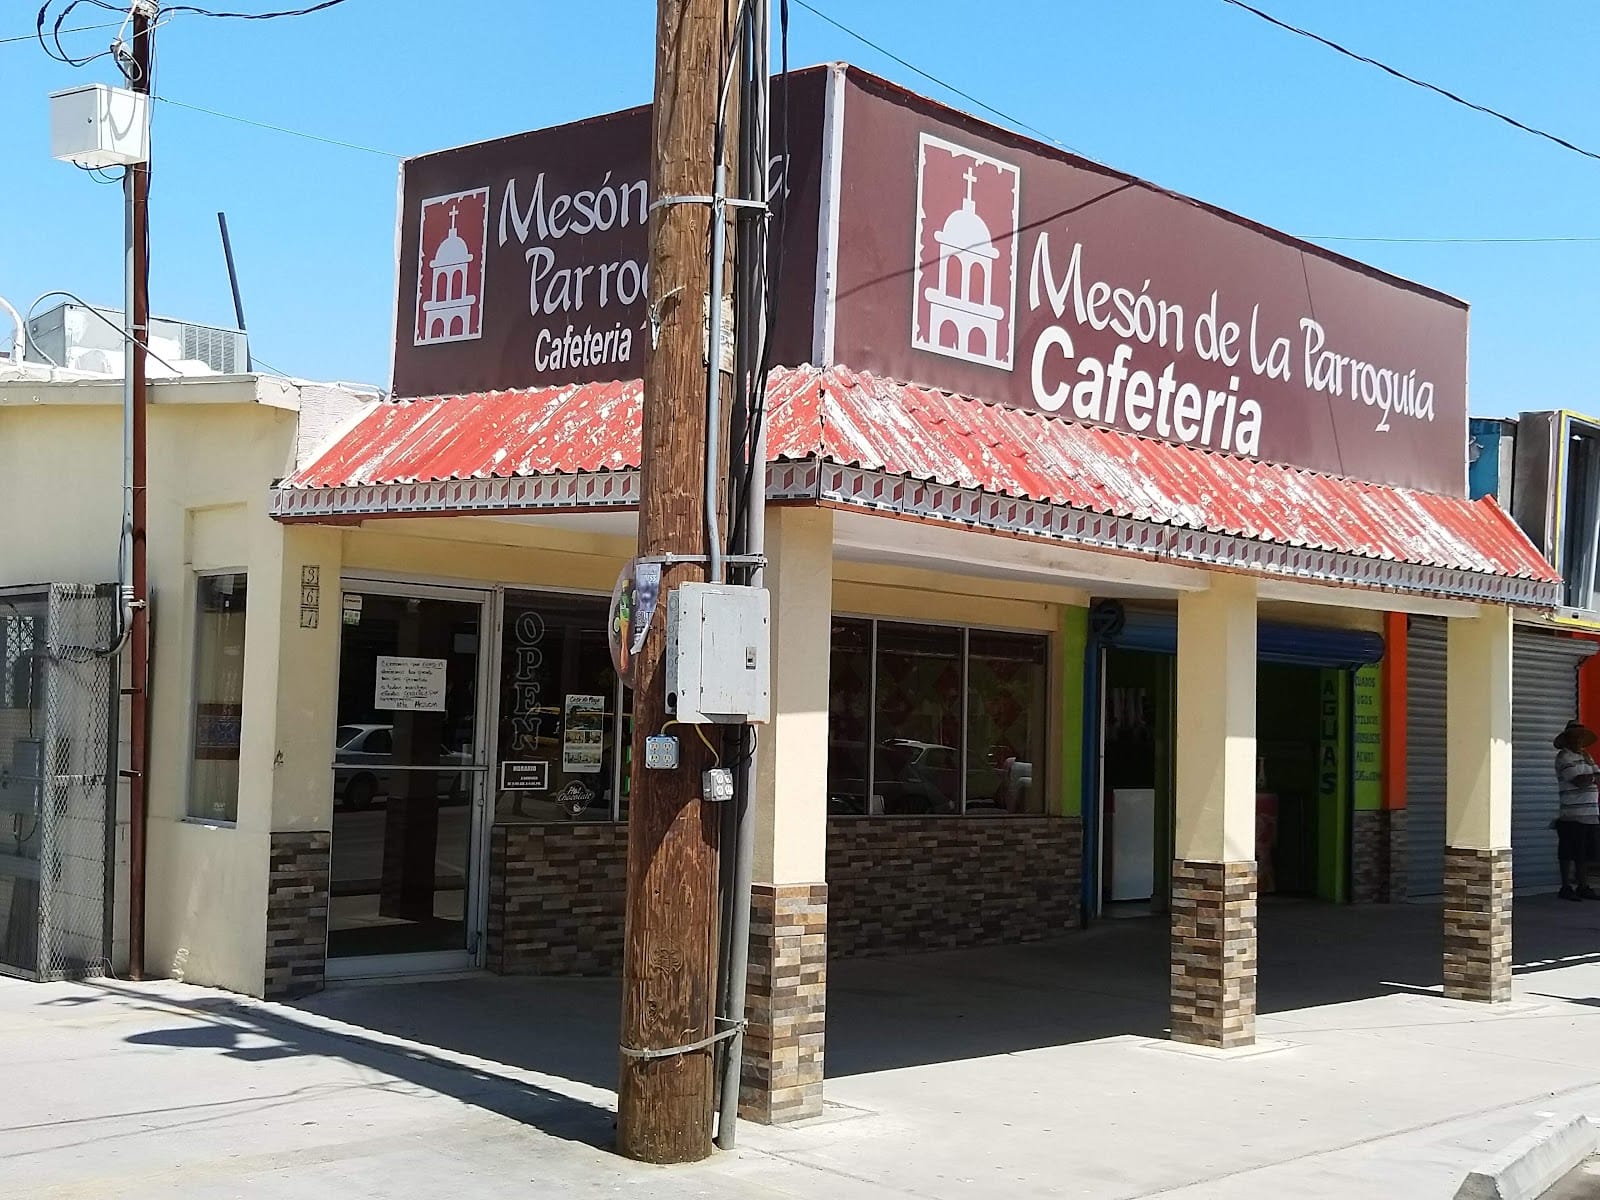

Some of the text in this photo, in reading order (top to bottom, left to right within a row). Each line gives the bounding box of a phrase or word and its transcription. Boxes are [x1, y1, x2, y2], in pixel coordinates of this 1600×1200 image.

[498, 170, 648, 247] Mesón
[534, 322, 633, 372] Cafeteria
[1029, 232, 1183, 353] Mesón
[1195, 289, 1240, 367] de
[1031, 326, 1263, 457] Cafeteria
[512, 611, 544, 750] OPEN
[1320, 681, 1337, 795] AGUAS
